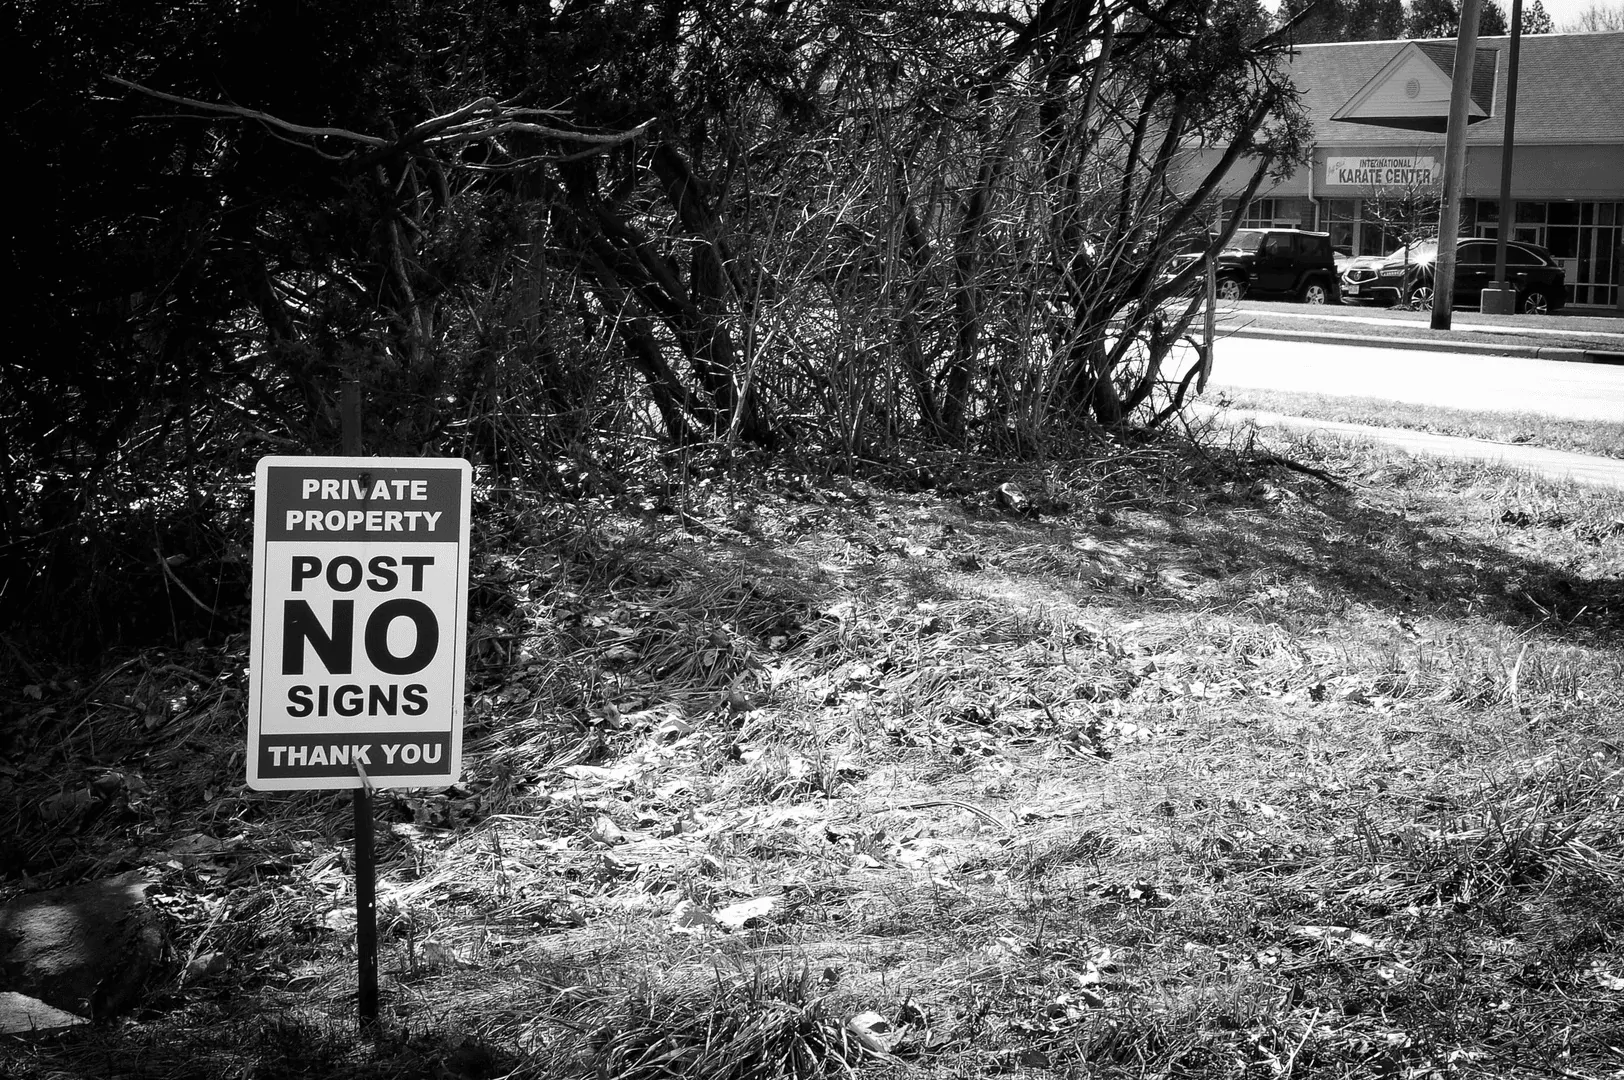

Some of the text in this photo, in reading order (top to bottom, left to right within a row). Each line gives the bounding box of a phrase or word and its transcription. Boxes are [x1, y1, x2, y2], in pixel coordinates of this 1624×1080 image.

[1339, 169, 1431, 184] KARATE CENTER
[302, 478, 428, 500] PRIVATE
[286, 510, 442, 532] PROPERTY
[291, 555, 435, 592] POST
[282, 598, 440, 675] NO
[286, 684, 429, 718] SIGNS
[268, 743, 442, 767] THANK YOU
